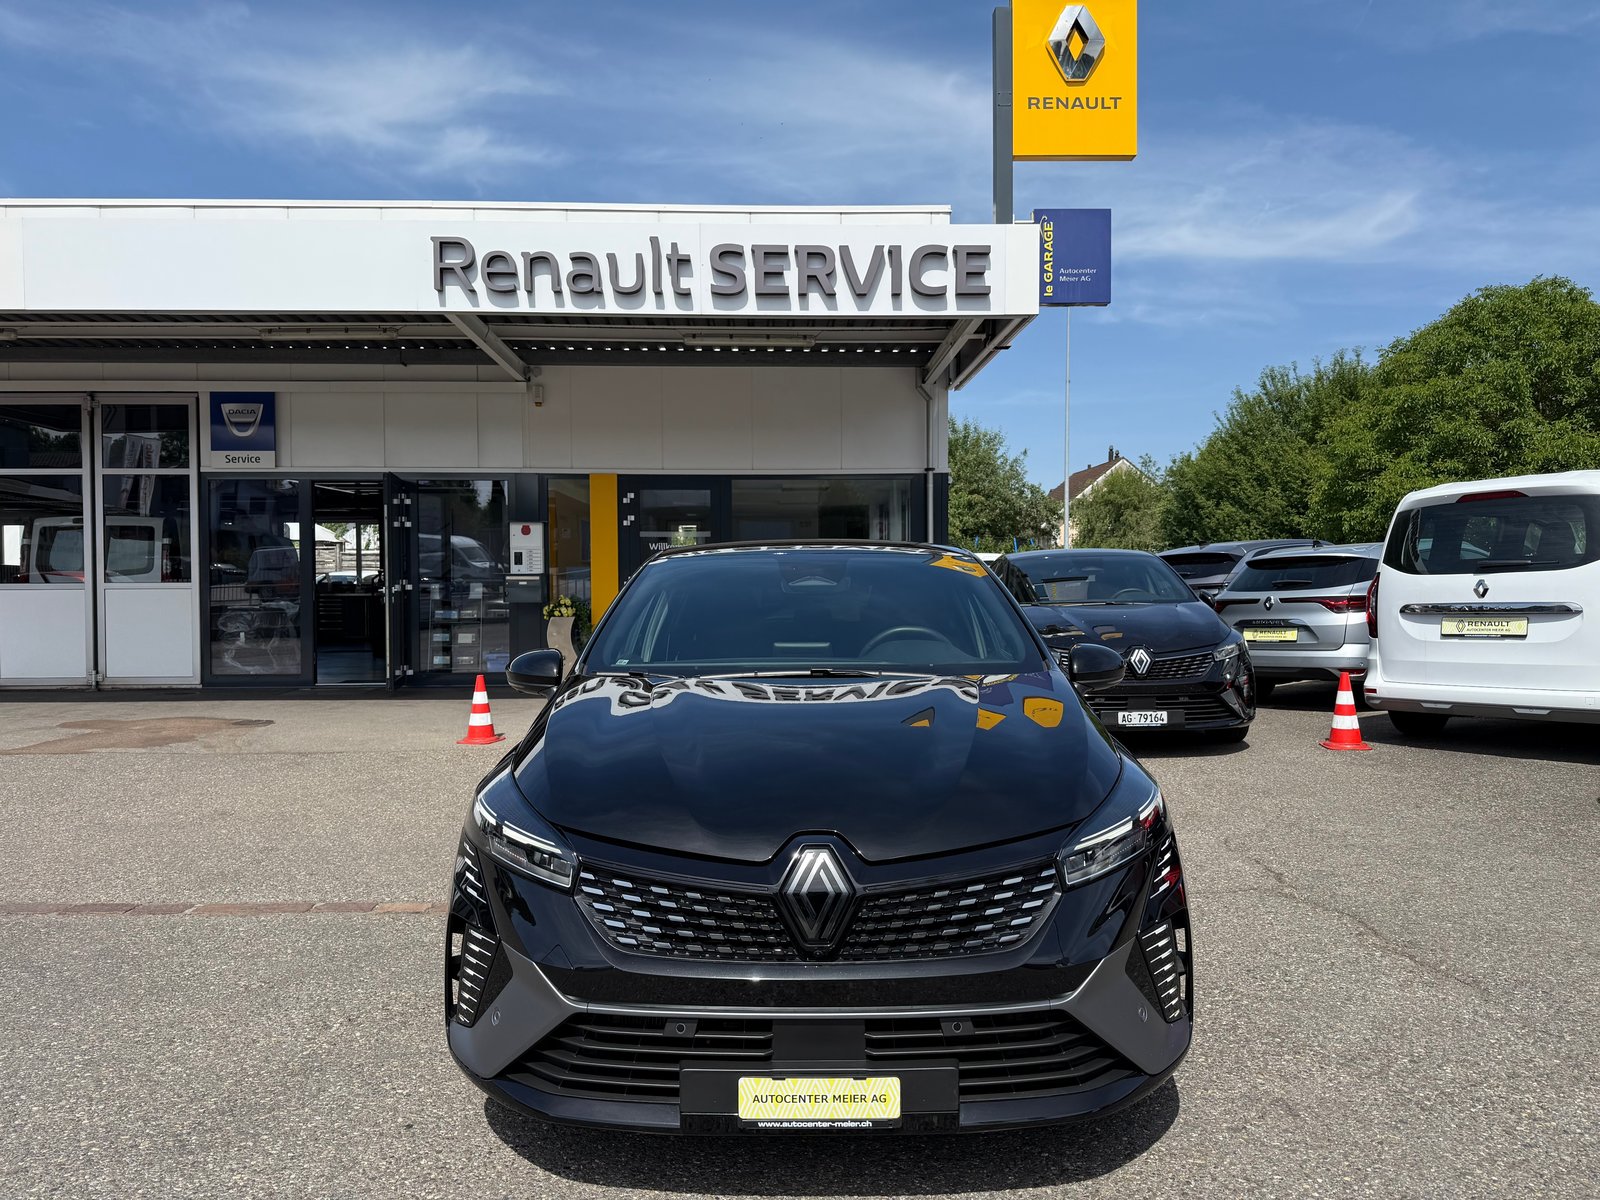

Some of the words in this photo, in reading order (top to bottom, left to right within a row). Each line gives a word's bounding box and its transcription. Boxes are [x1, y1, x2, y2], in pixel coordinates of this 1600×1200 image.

[1027, 96, 1122, 110] RENAULT
[1043, 221, 1054, 283] GARAGE
[430, 235, 692, 296] Renault
[709, 243, 992, 297] SERVICE
[1043, 285, 1054, 297] le
[225, 454, 261, 464] Service
[1467, 620, 1511, 628] RENAULT
[1137, 713, 1165, 723] 79164
[752, 1094, 829, 1104] AUTOCENTER
[832, 1094, 868, 1104] MEIER
[870, 1094, 888, 1104] AG
[757, 1120, 873, 1128] www.autocenter-meier.ch
